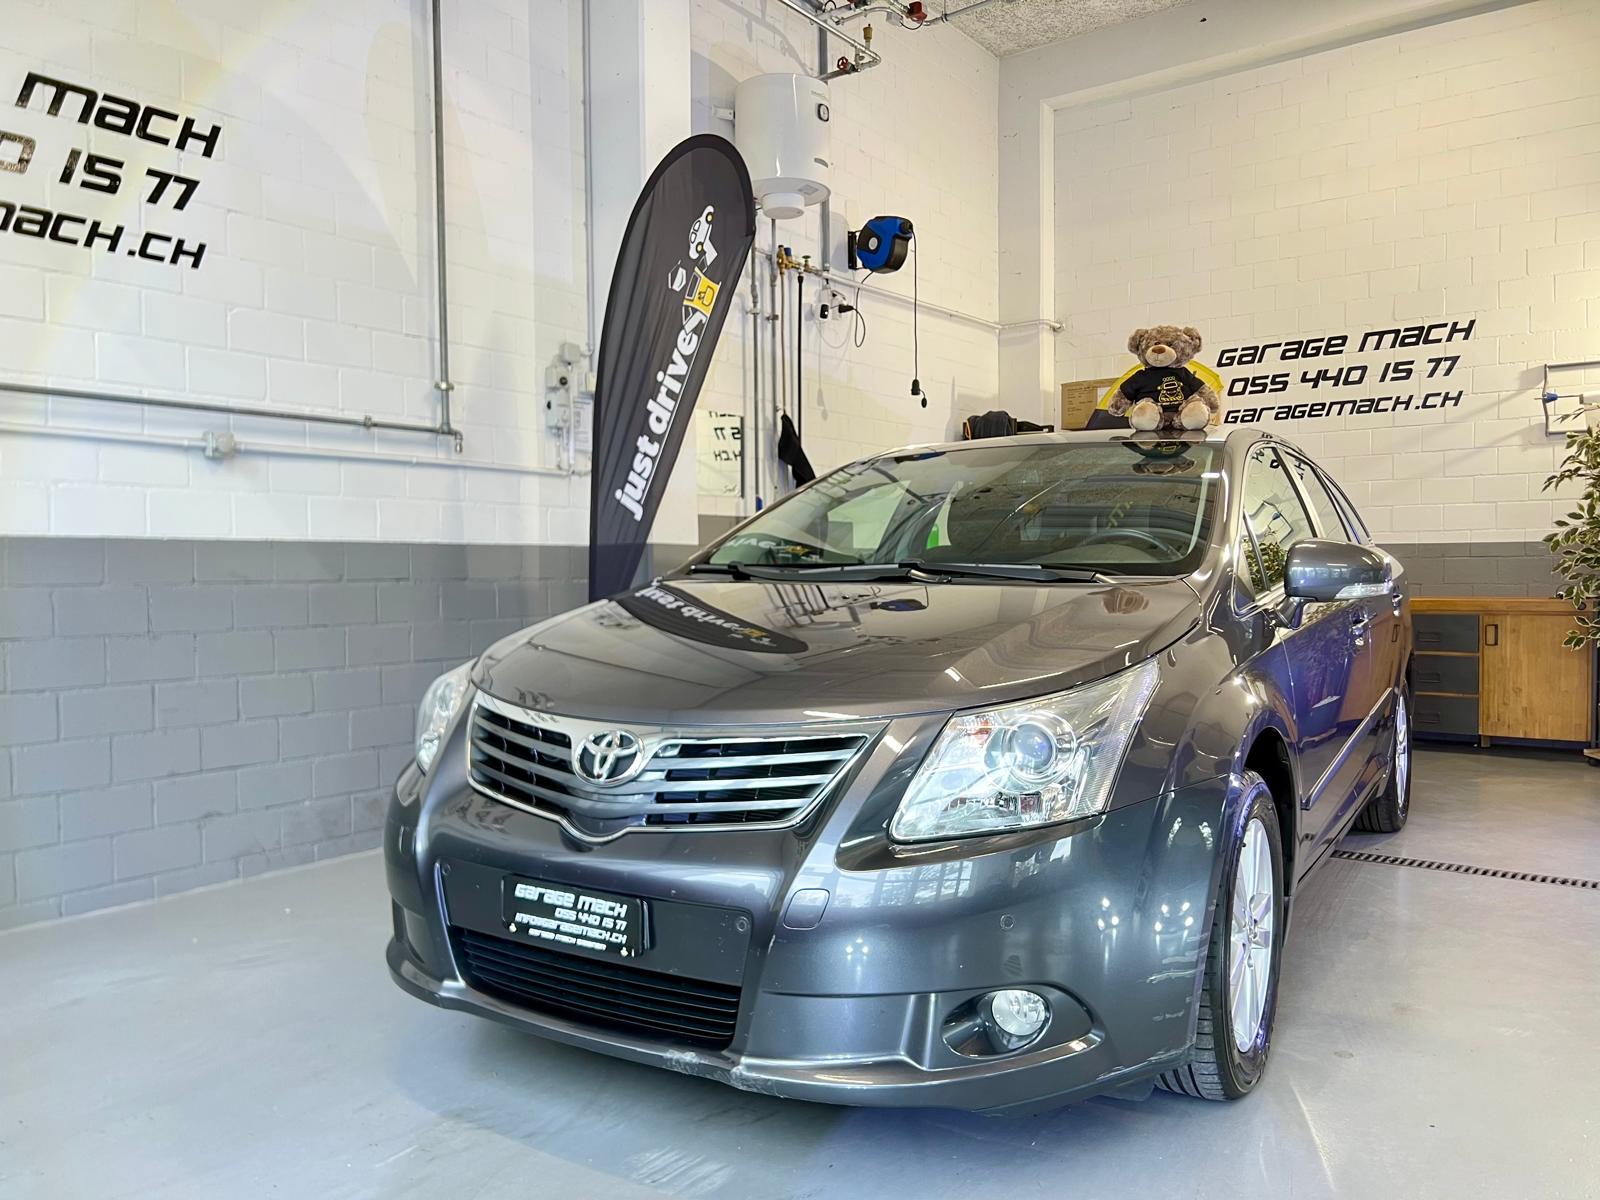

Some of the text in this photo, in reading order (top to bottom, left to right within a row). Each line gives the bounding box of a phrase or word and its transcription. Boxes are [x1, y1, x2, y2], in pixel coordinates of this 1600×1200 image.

[59, 147, 125, 195] 15
[145, 167, 201, 211] 77
[1227, 355, 1461, 397] 055 440 15 77
[615, 434, 660, 522] just
[554, 907, 577, 921] 055
[578, 911, 600, 926] 440
